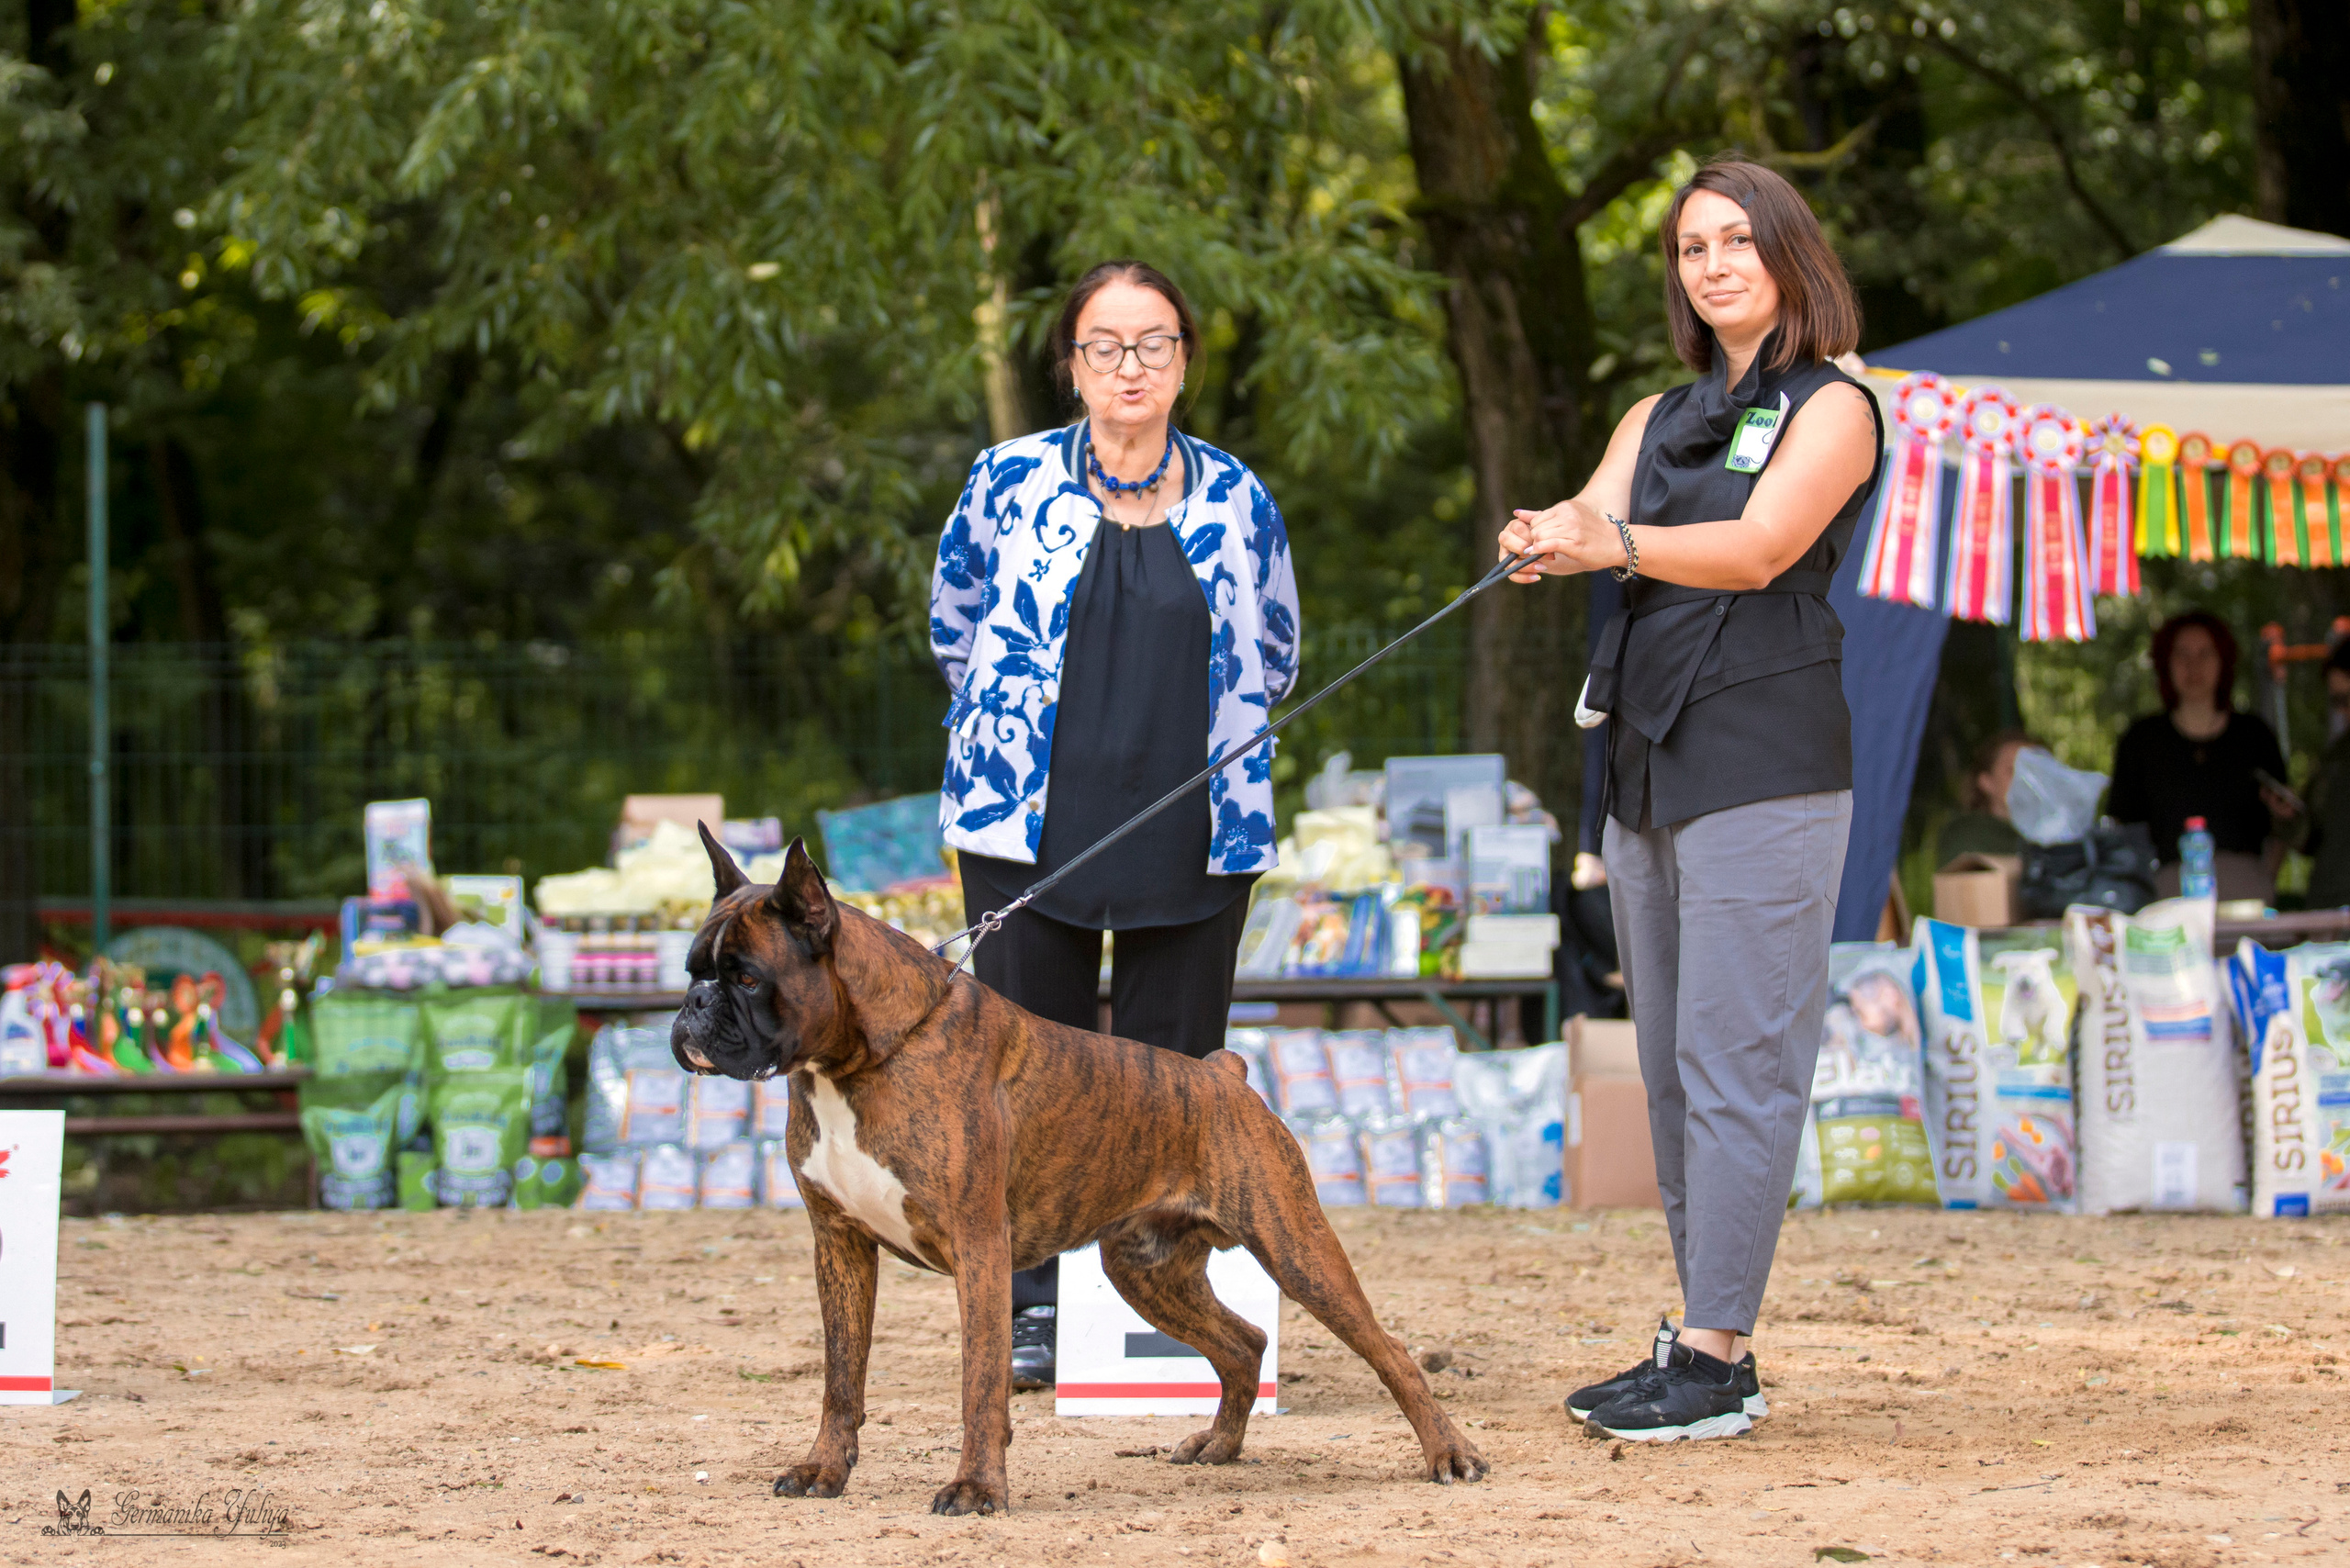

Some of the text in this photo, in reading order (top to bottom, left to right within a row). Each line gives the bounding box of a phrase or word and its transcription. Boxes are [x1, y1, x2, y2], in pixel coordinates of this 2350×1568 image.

[1943, 1032, 1978, 1181] SIRIUS
[2103, 979, 2134, 1113] SIRIUS
[2270, 1028, 2306, 1171] SIRIUS
